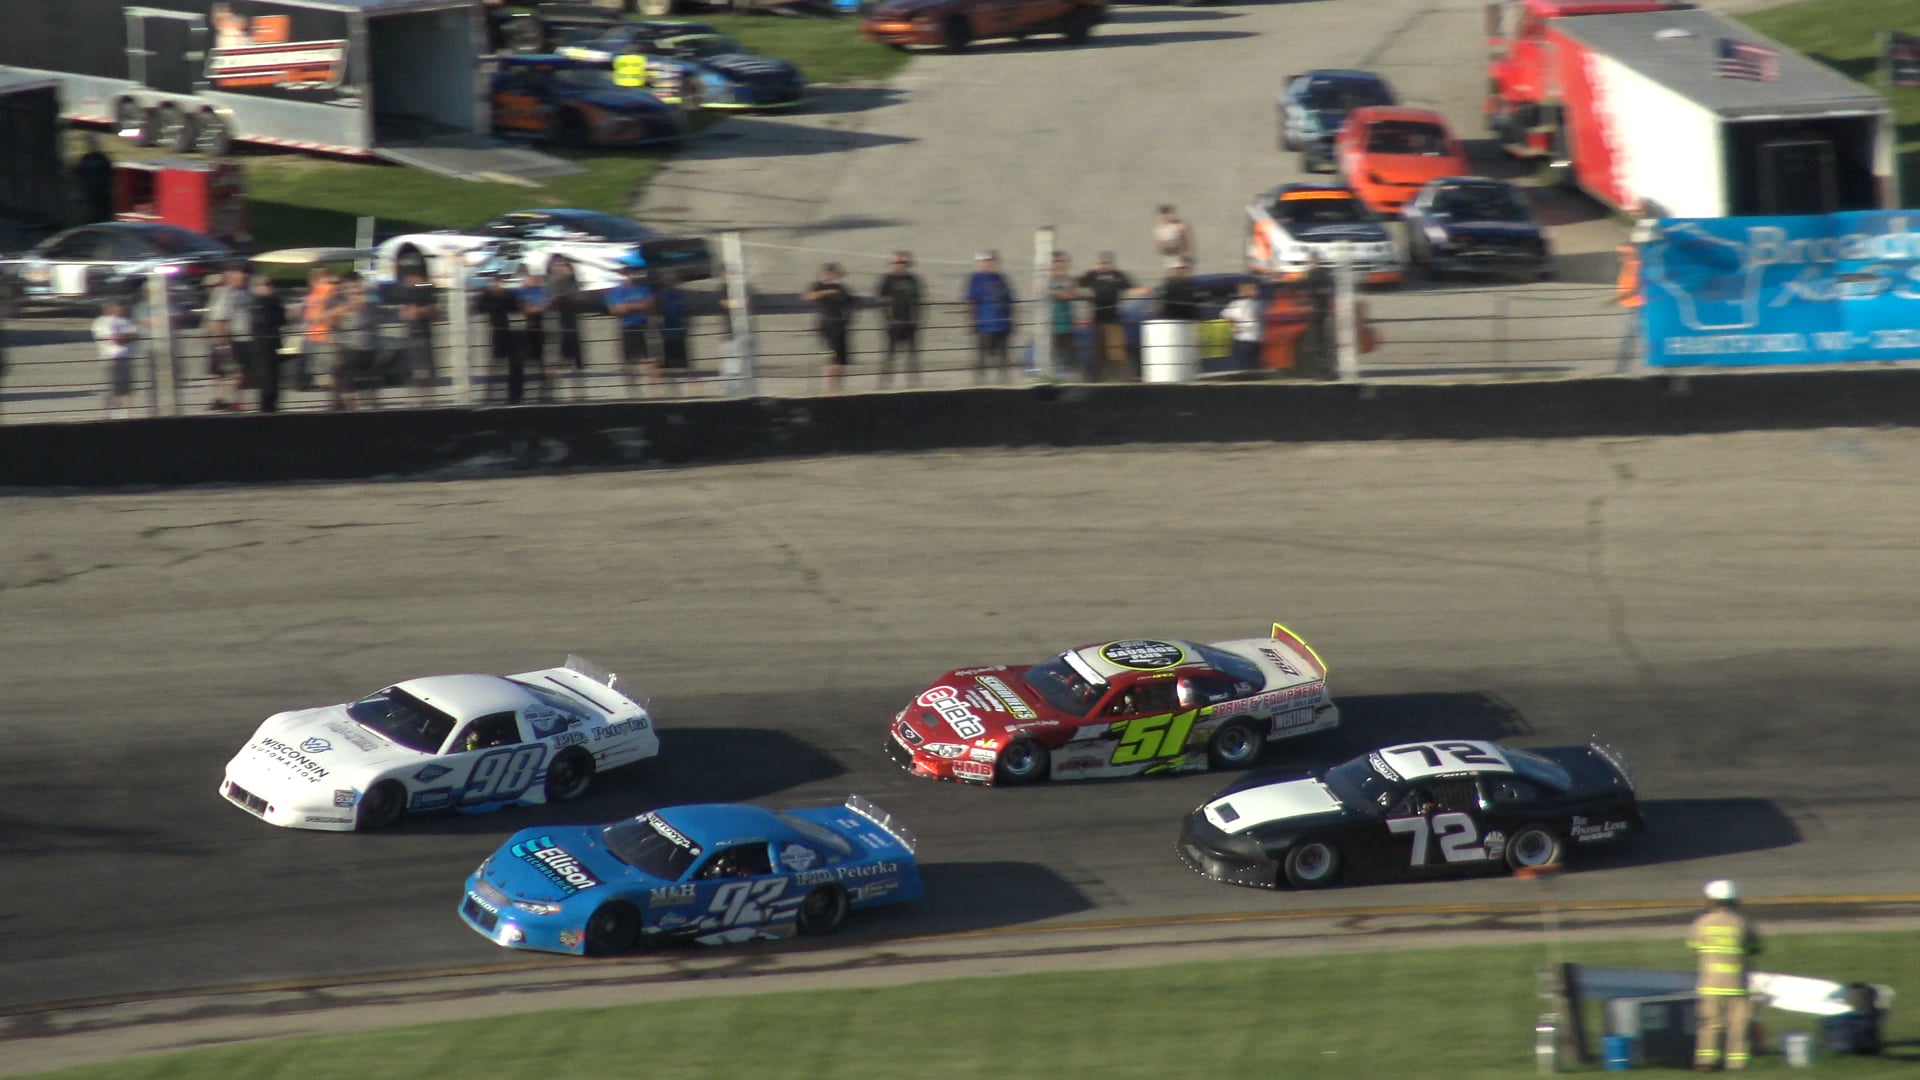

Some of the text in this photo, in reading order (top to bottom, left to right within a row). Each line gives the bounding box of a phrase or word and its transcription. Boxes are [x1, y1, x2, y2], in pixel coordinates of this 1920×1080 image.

[1106, 646, 1178, 658] SAUSAGE
[1263, 683, 1325, 706] EQUIPMENT
[1111, 709, 1198, 765] 51
[1386, 742, 1505, 768] 72
[252, 744, 320, 783] AUTOMATION
[261, 737, 330, 778] WISCONSIN
[463, 744, 547, 801] 98
[953, 761, 991, 775] HMB
[1386, 812, 1488, 866] 72
[524, 855, 577, 895] TECHNOLOGIES
[533, 846, 597, 889] Ellison
[836, 860, 897, 880] Peterka
[467, 890, 499, 914] FUSION
[650, 884, 696, 901] M&H
[708, 877, 789, 926] 92
